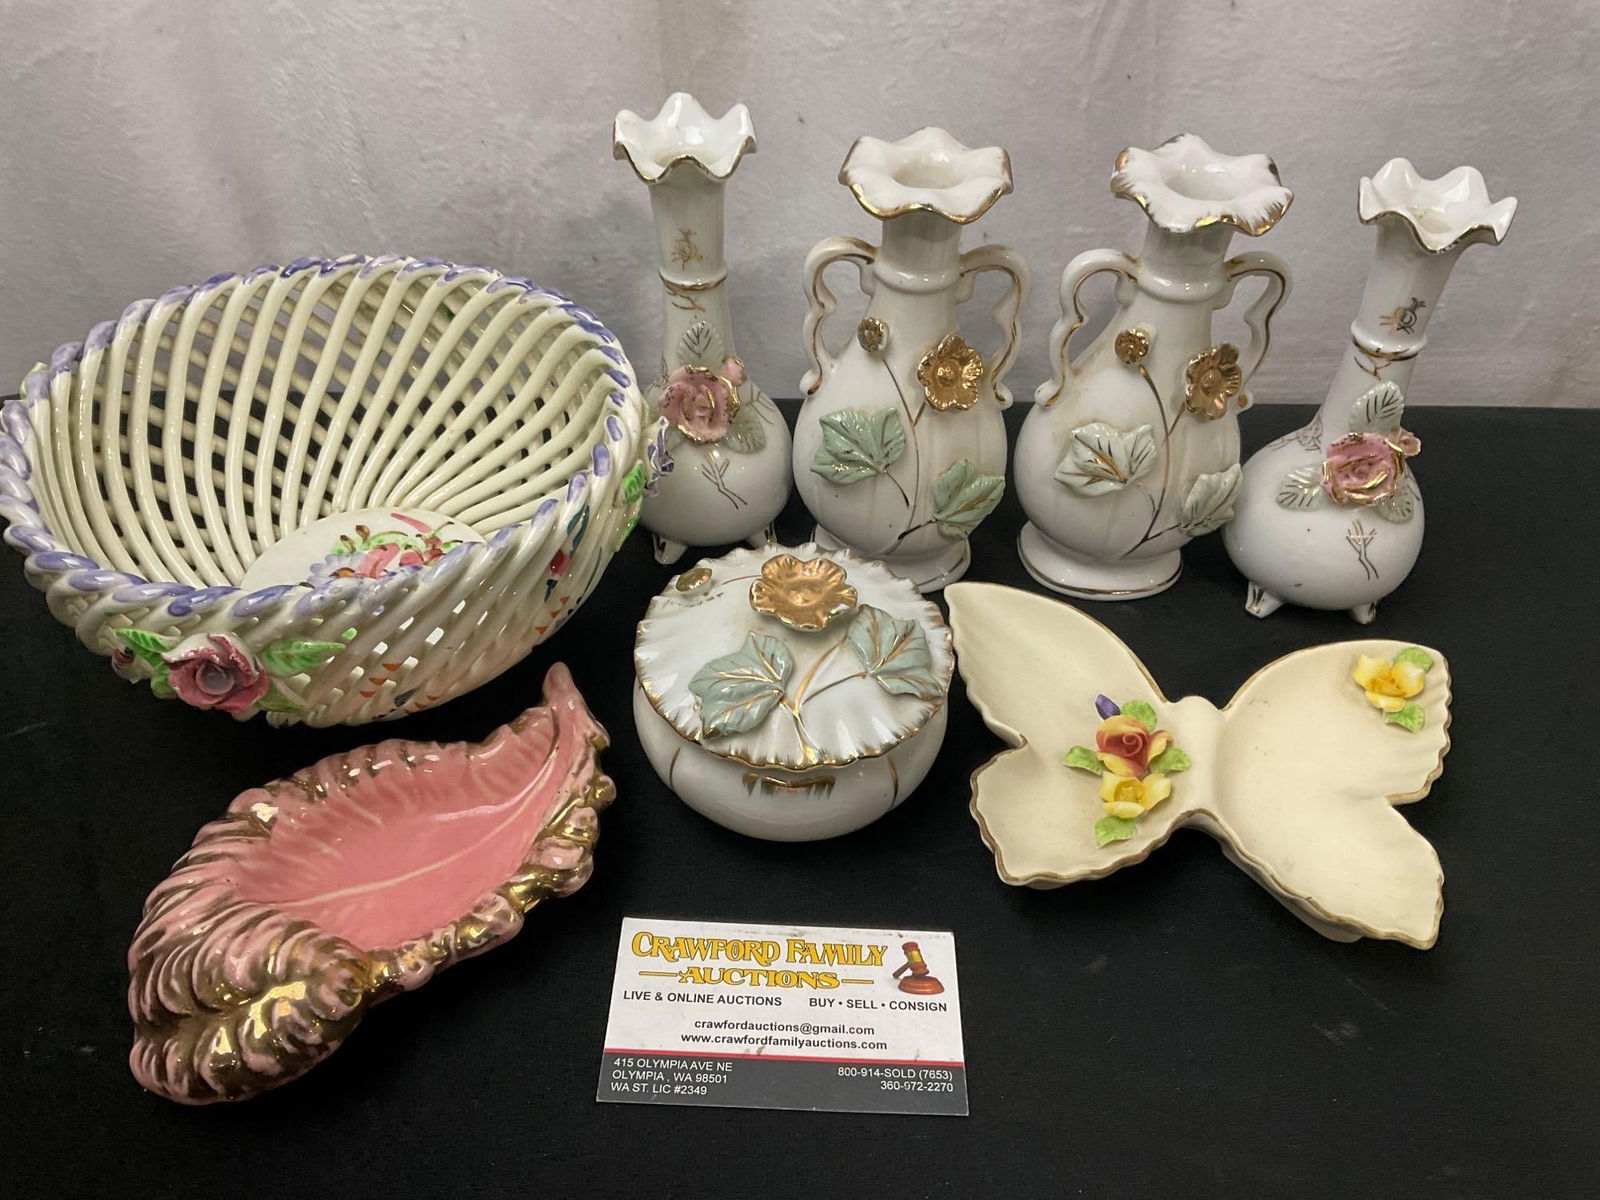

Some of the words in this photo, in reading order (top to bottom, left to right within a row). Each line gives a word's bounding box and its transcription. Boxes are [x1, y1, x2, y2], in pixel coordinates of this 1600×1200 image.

[631, 931, 780, 967] CRAWFORD
[786, 938, 888, 967] FAMILY
[678, 966, 840, 990] AUCTIONS
[623, 990, 651, 1001] LIVE
[654, 991, 663, 1001] &
[667, 992, 714, 1004] ONLINE
[717, 994, 782, 1006] AUCTIONS
[809, 997, 835, 1008] BUY
[846, 999, 878, 1010] SELL
[889, 1001, 947, 1012] CONSIGN
[694, 1019, 875, 1035] crawfordauctions@gmail.com
[681, 1033, 888, 1050] www.crawfordfamilyauctions.com
[613, 1058, 634, 1068] 415
[636, 1058, 688, 1070] OLYMPIA
[689, 1061, 713, 1071] AVE
[716, 1062, 733, 1072] NE
[673, 1072, 692, 1082] WA
[695, 1073, 728, 1084] 98501
[837, 1066, 916, 1079] 800-914-SOLD
[918, 1069, 953, 1081] (7653)
[610, 1082, 630, 1092] WA
[632, 1083, 649, 1093] ST.
[652, 1084, 671, 1094] LIC
[673, 1085, 708, 1095] #2349
[880, 1080, 954, 1092] 360-972-2270
